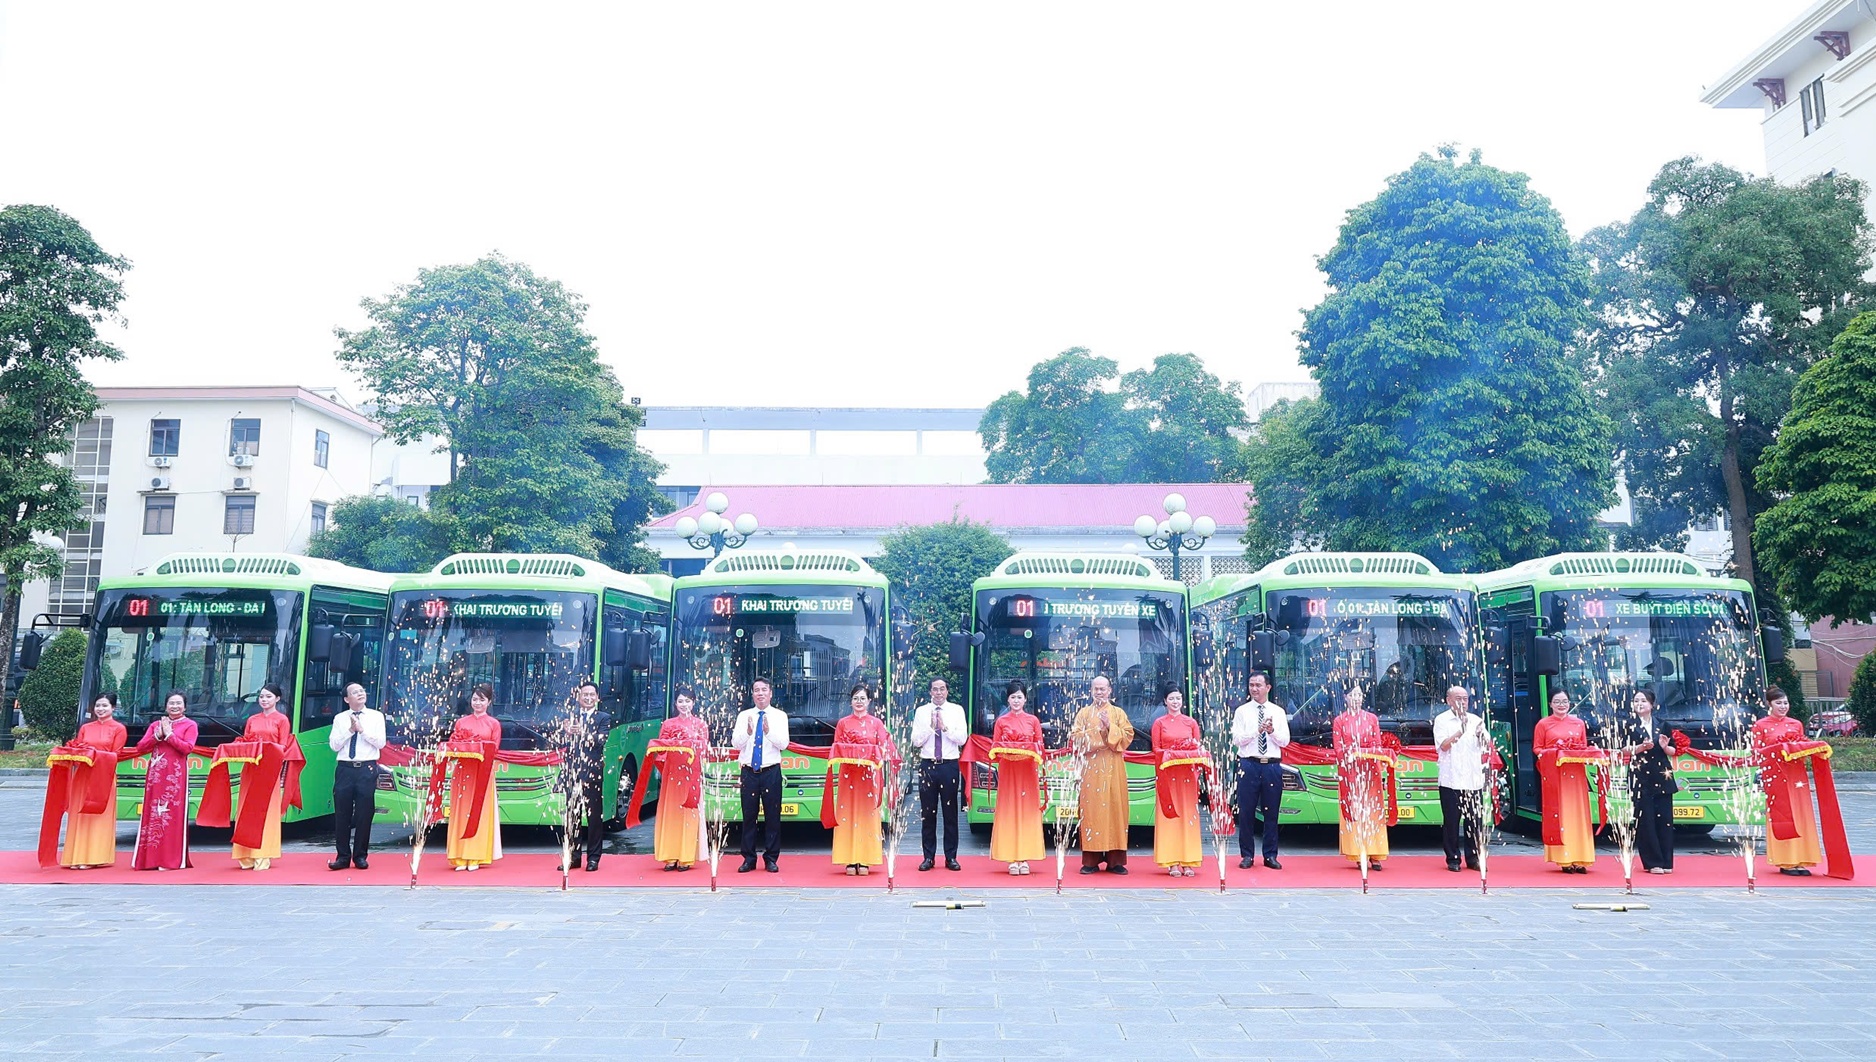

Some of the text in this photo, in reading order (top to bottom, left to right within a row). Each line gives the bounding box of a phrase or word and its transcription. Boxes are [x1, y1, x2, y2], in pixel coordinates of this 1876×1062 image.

[129, 599, 148, 616] 01
[160, 602, 177, 613] 01:
[179, 600, 201, 613] TÂN
[204, 602, 235, 613] LONG
[426, 600, 444, 617] 01
[479, 604, 527, 615] TRƯƠNG
[714, 597, 731, 614] 01
[741, 599, 767, 611] KHAI
[1016, 600, 1033, 616] 01
[1142, 605, 1156, 616] XE
[1308, 599, 1325, 616] 01
[1392, 603, 1422, 614] LONG
[1586, 600, 1604, 617] 01
[1616, 603, 1630, 614] XE
[1633, 601, 1662, 614] BUÝT
